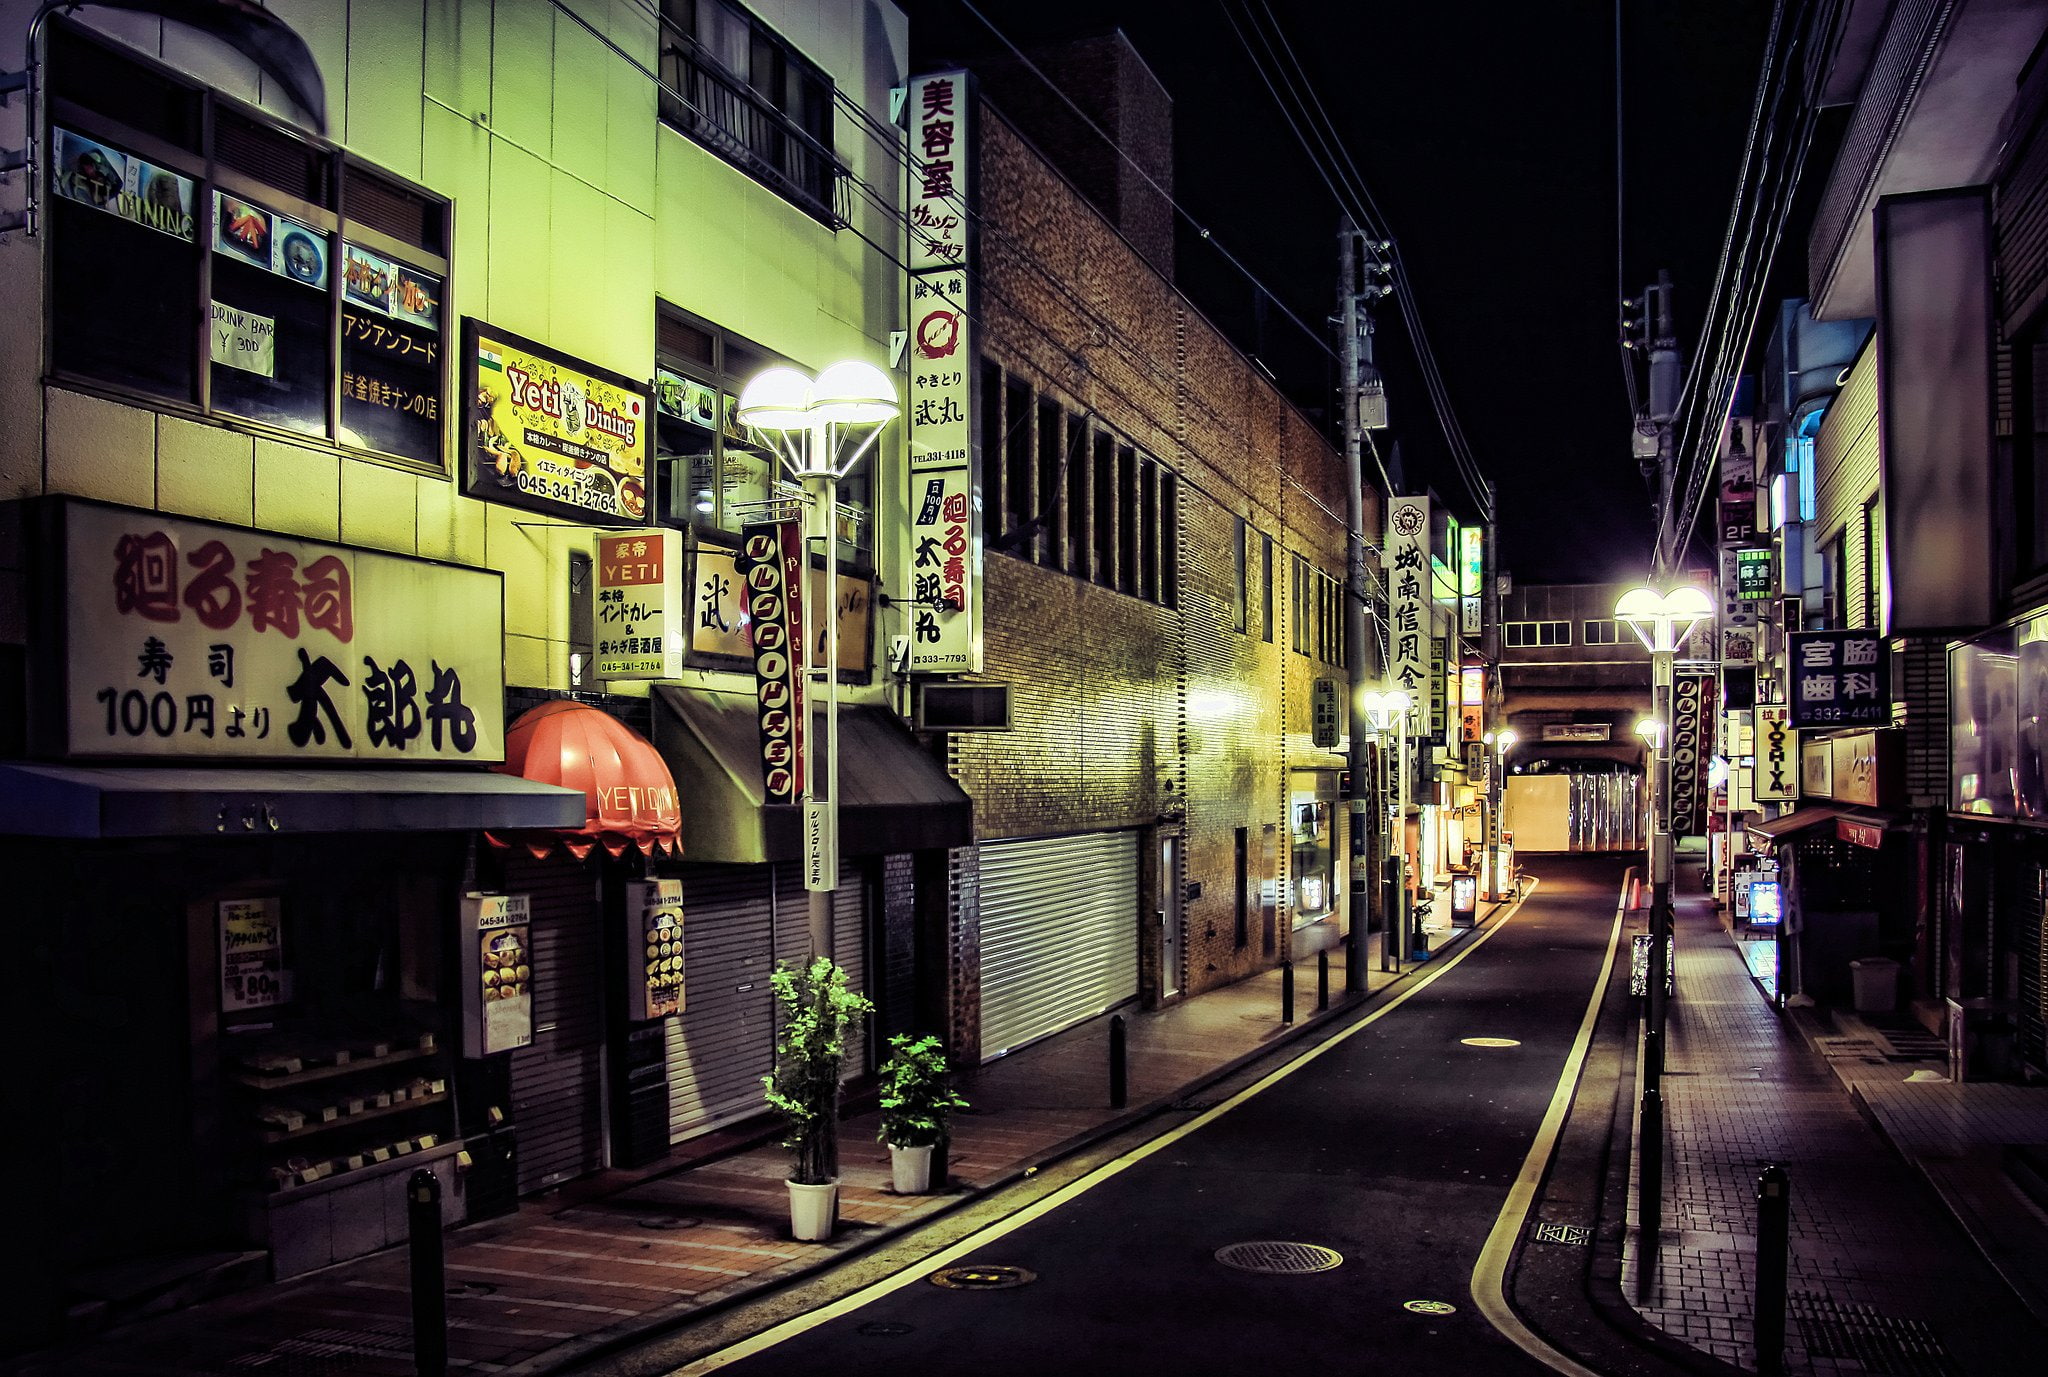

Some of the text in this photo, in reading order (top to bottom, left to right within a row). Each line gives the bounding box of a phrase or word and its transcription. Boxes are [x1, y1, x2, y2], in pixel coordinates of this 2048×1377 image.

[921, 79, 954, 199] 美容室
[117, 190, 193, 240] DINING
[911, 203, 959, 229] サムソン
[942, 229, 952, 239] &
[914, 279, 962, 299] 炭火焼
[211, 305, 274, 337] DRINK BAR
[219, 330, 259, 353] ¥ 300
[343, 314, 437, 364] アジアンフード
[916, 371, 962, 389] やきとり
[343, 371, 437, 420] 炭釜焼きナンの店
[507, 366, 636, 448] Yeti Dining
[915, 396, 964, 426] 武丸
[519, 473, 617, 514] 045-341-2764
[1726, 526, 1751, 539] 2F
[943, 492, 968, 612] 廻る寿司
[605, 563, 657, 581] YETI
[1740, 564, 1769, 579] 麻雀
[113, 531, 354, 644] 廻る寿司
[599, 589, 624, 602] 本格
[915, 536, 943, 644] 太郎丸
[599, 602, 663, 624] インドカレー
[625, 624, 635, 635] &
[599, 637, 662, 655] 安らぎ居酒屋
[921, 655, 966, 664] 333-7793
[1801, 638, 1878, 667] 宮脇
[137, 636, 234, 688] 寿司
[601, 661, 661, 672] 045-341-2764
[286, 647, 477, 753] 太郎丸
[1431, 662, 1440, 727] 明光
[1801, 672, 1878, 701] 歯科
[97, 686, 270, 739] 100円より
[1814, 706, 1882, 720] 332-4411
[1768, 720, 1786, 791] YOSHIYA
[597, 786, 646, 811] YETI
[498, 900, 525, 913] YETI
